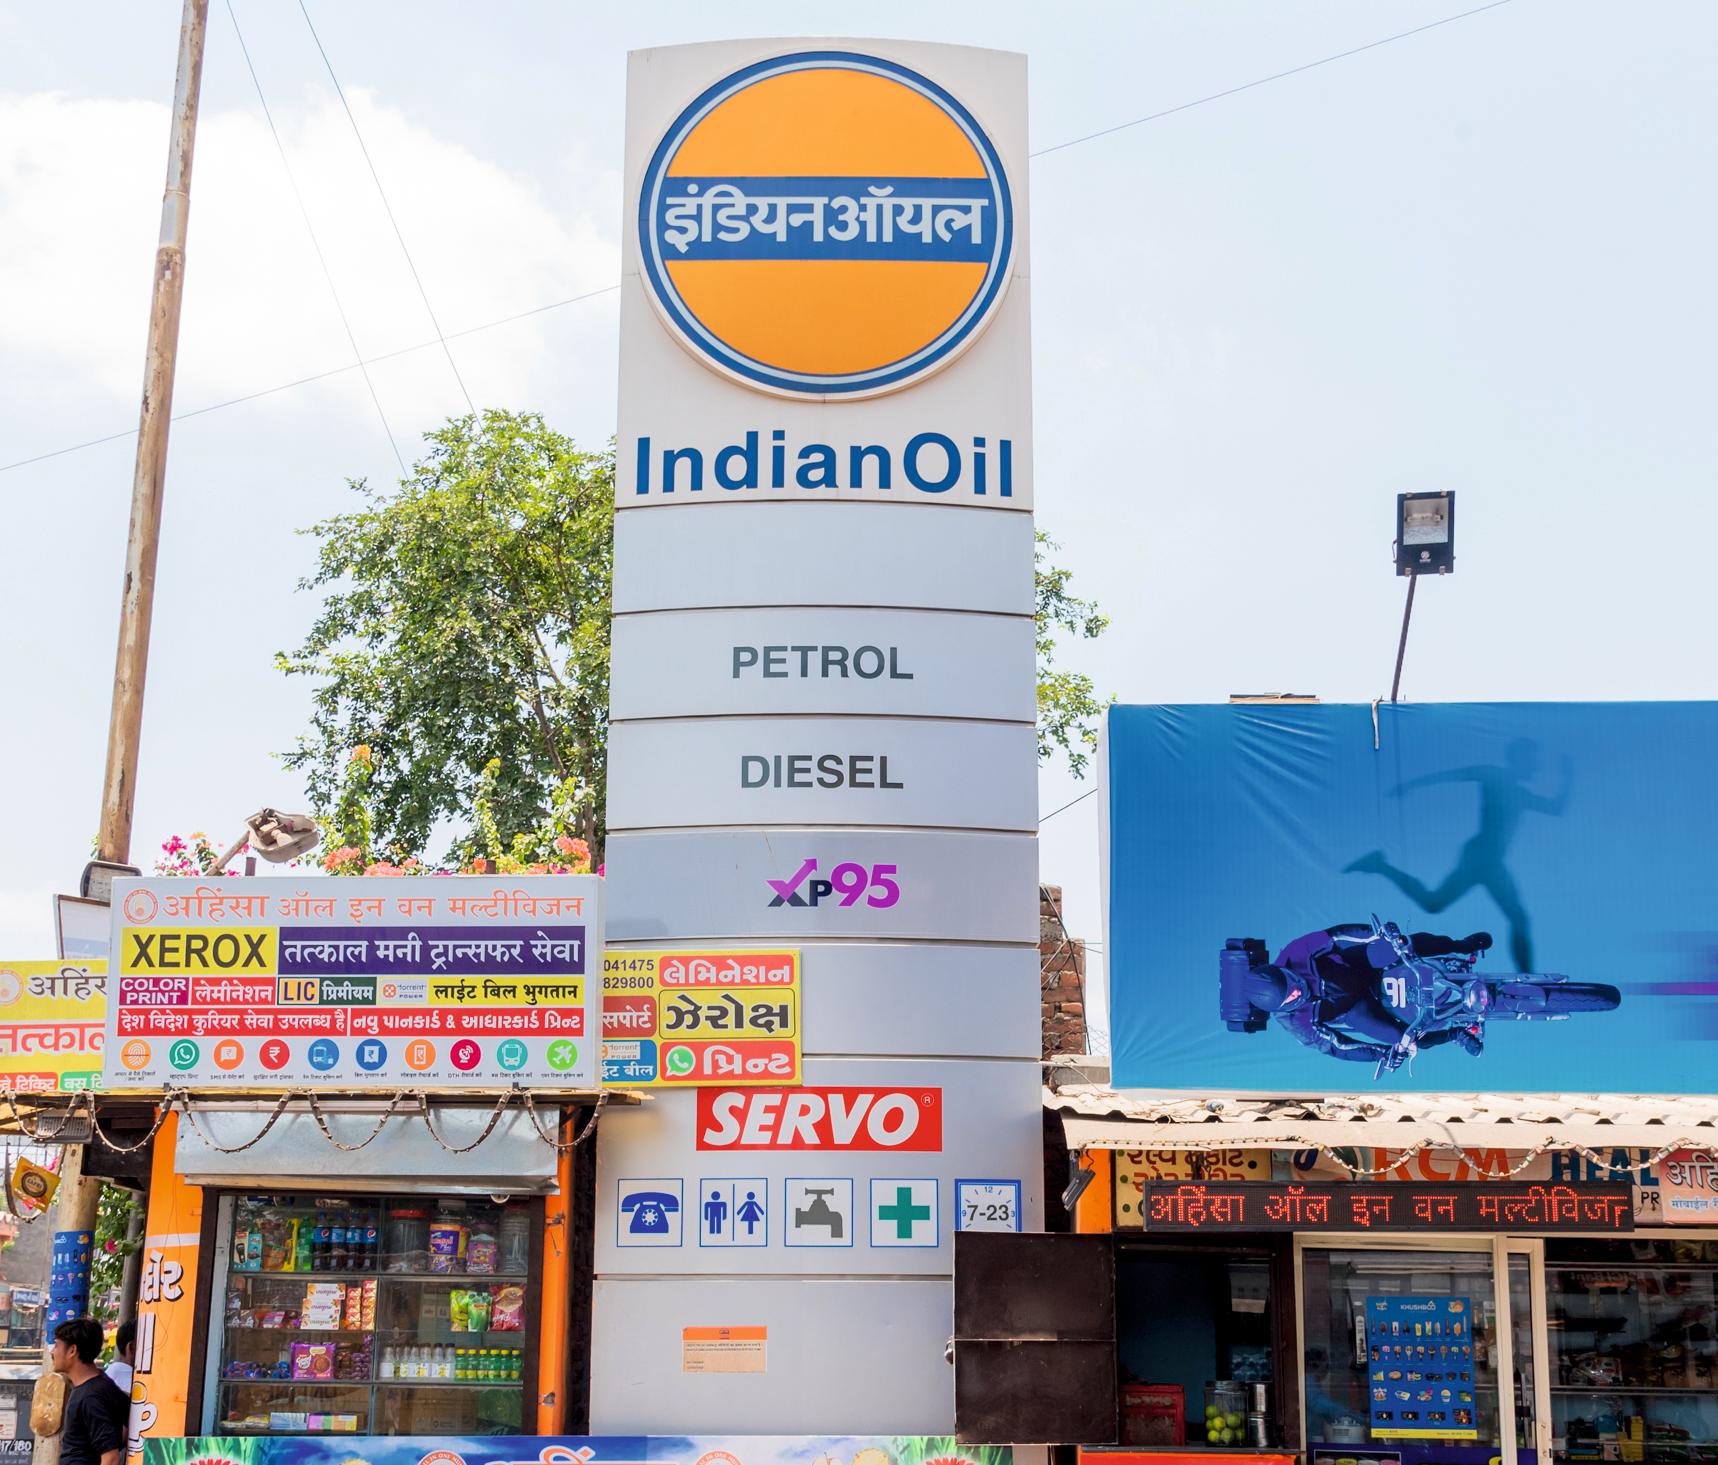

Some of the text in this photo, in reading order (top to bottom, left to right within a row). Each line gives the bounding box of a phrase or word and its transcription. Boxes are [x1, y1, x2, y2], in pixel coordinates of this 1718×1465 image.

[664, 184, 988, 254] इंडियनऑयल
[636, 430, 1012, 498] IndianOil
[732, 645, 914, 680] PETROL
[741, 754, 904, 789] DIESEL
[766, 858, 900, 909] XP95
[163, 887, 585, 923] अहिंसा ऑल इन वन मल्टीविजन
[130, 933, 267, 968] XEROX
[282, 930, 581, 970] तत्काल मनी ट्रान्सफर सेवा
[603, 959, 654, 972] 041475
[663, 958, 790, 984] લેમિનેશન
[121, 978, 187, 991] COLOR
[194, 980, 274, 1003] लेमीनेशन
[283, 981, 316, 1001] LIC
[321, 980, 374, 1000] प्रिमीयम
[433, 979, 578, 1005] लाईट बिल भुगतान
[602, 976, 654, 989] 829800
[1383, 977, 1406, 1008] 91
[126, 992, 180, 1004] PRINT
[121, 1009, 345, 1035] देश विदेश कुरियर सेवा उपलब्ध है
[384, 1010, 441, 1029] પાનકાર્ડ
[446, 1014, 456, 1028] &
[461, 1010, 540, 1029] આધારકાર્ડ
[544, 1010, 581, 1029] પ્રિન્ટ
[665, 993, 789, 1034] ઝેરોક્ષ
[623, 1061, 654, 1077] बील
[703, 1045, 792, 1075] પ્રિન્ટ
[703, 1091, 920, 1147] SERVO
[967, 1204, 1010, 1221] 7-23
[1151, 1185, 1246, 1227] अहिंसा
[1264, 1186, 1332, 1223] ऑल
[1350, 1195, 1393, 1227] इन
[1413, 1195, 1458, 1222] वन
